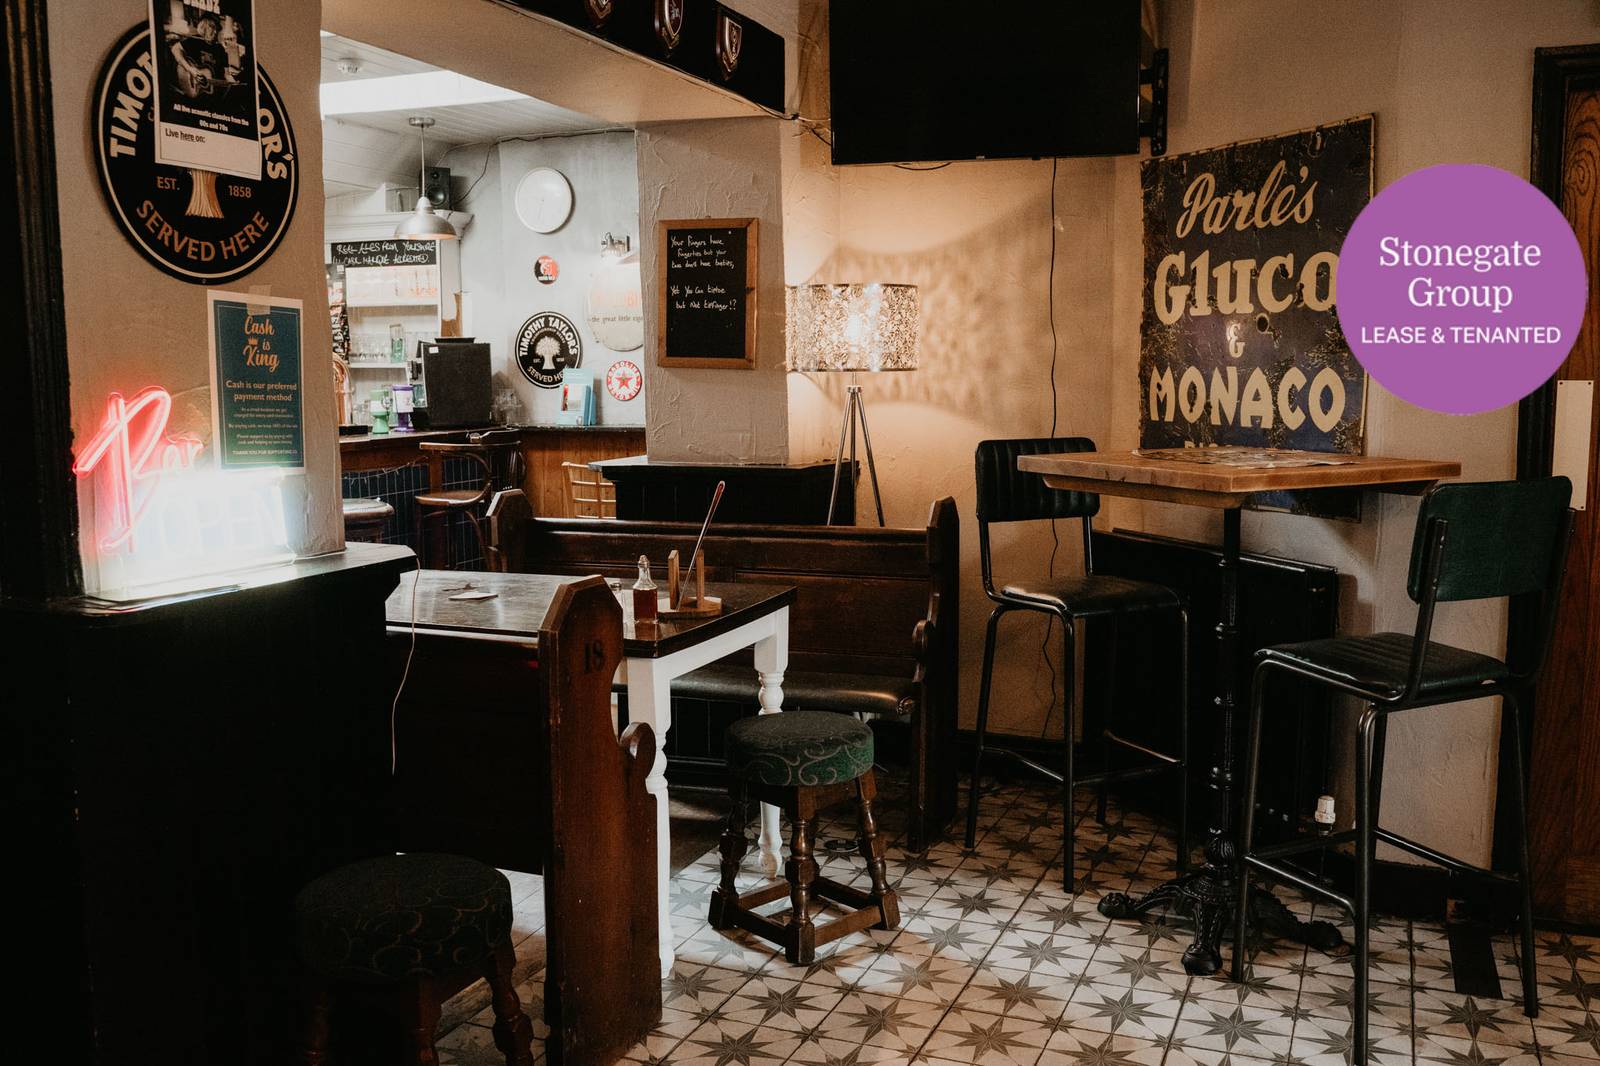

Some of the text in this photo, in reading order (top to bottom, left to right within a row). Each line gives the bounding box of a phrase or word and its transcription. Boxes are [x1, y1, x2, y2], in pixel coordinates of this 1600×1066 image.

[110, 51, 154, 158] TIMOT
[165, 128, 206, 144] Live here on:
[156, 176, 252, 198] EST. 1858
[1175, 159, 1319, 239] Parle's
[136, 200, 270, 262] SERVED HERE
[671, 235, 684, 248] Your
[244, 315, 275, 336] Cash
[520, 317, 545, 356] TIMOTHY
[262, 338, 270, 351] is
[1226, 320, 1245, 359] &
[242, 345, 280, 373] King
[528, 366, 552, 382] SERVED
[226, 380, 245, 388] Cash
[267, 382, 296, 392] preferred
[234, 394, 292, 402] payment method
[1149, 365, 1346, 434] MONACO
